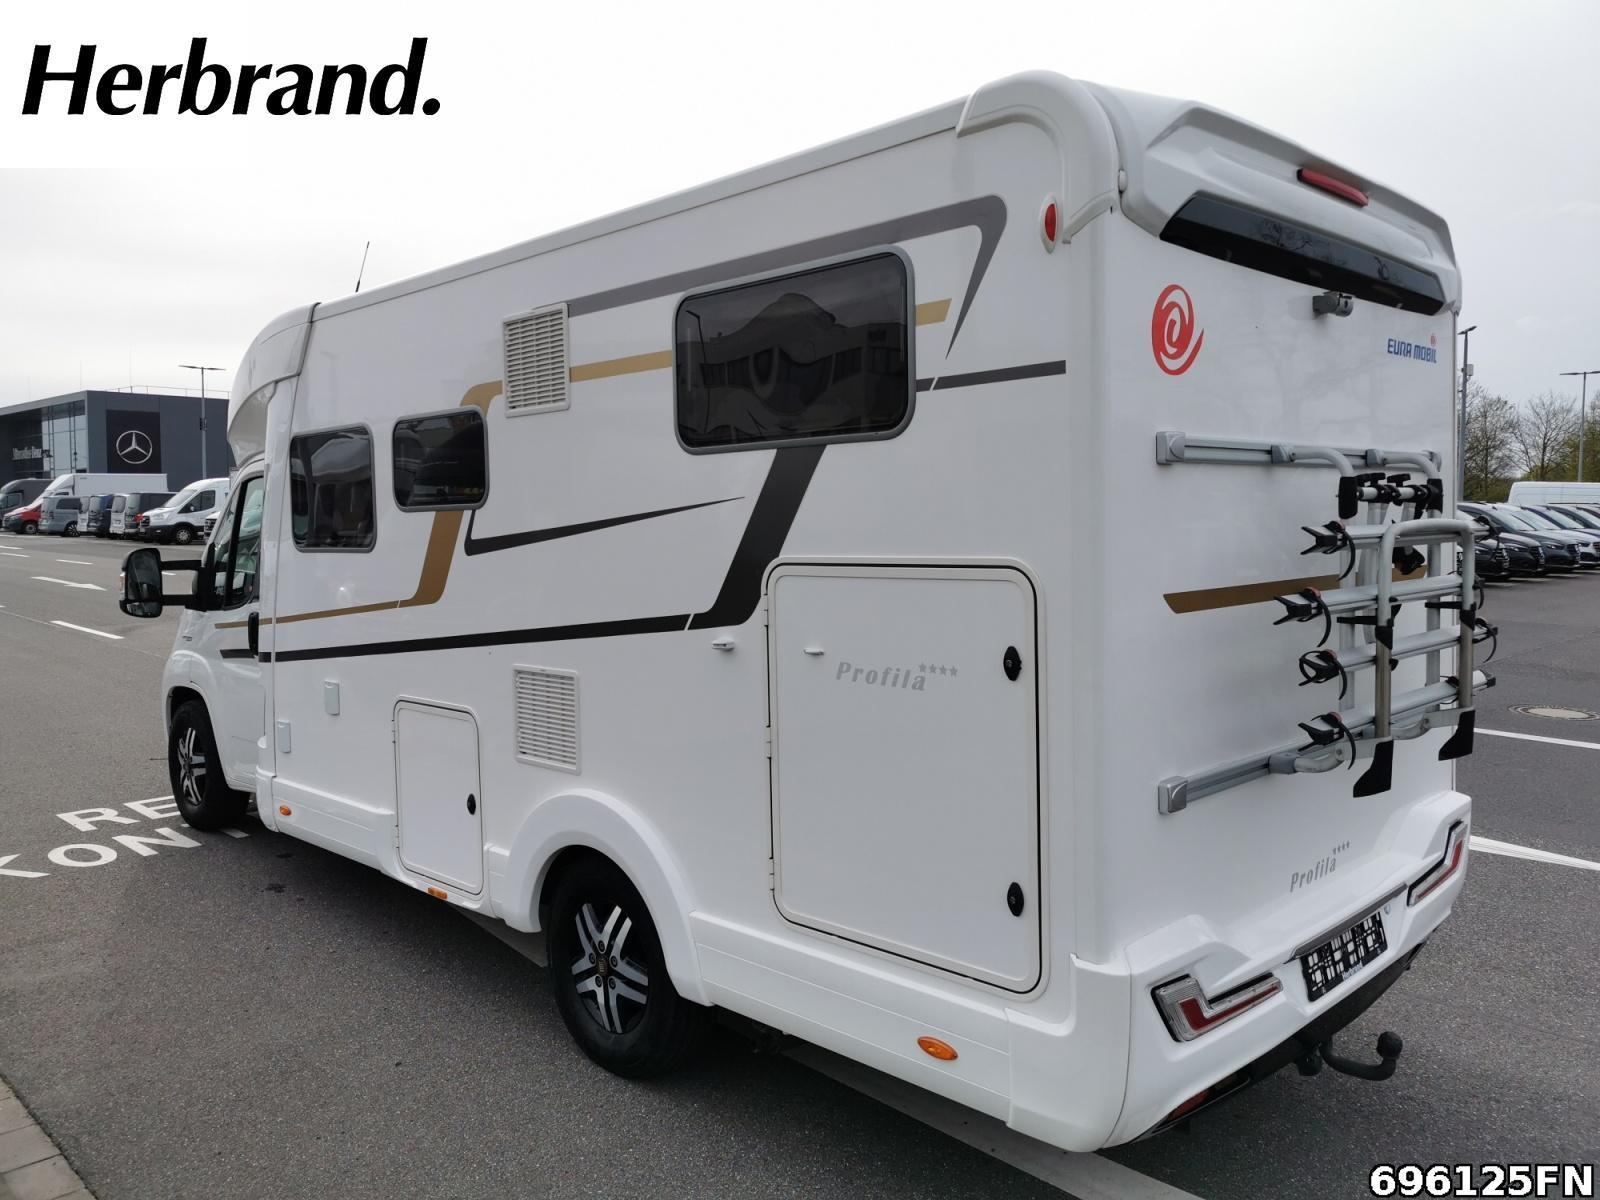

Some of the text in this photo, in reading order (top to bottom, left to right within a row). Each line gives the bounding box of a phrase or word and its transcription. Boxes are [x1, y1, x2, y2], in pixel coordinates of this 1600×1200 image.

[1387, 338, 1437, 363] EURA MOBIL
[836, 661, 926, 691] Profila
[1290, 857, 1337, 892] Profila
